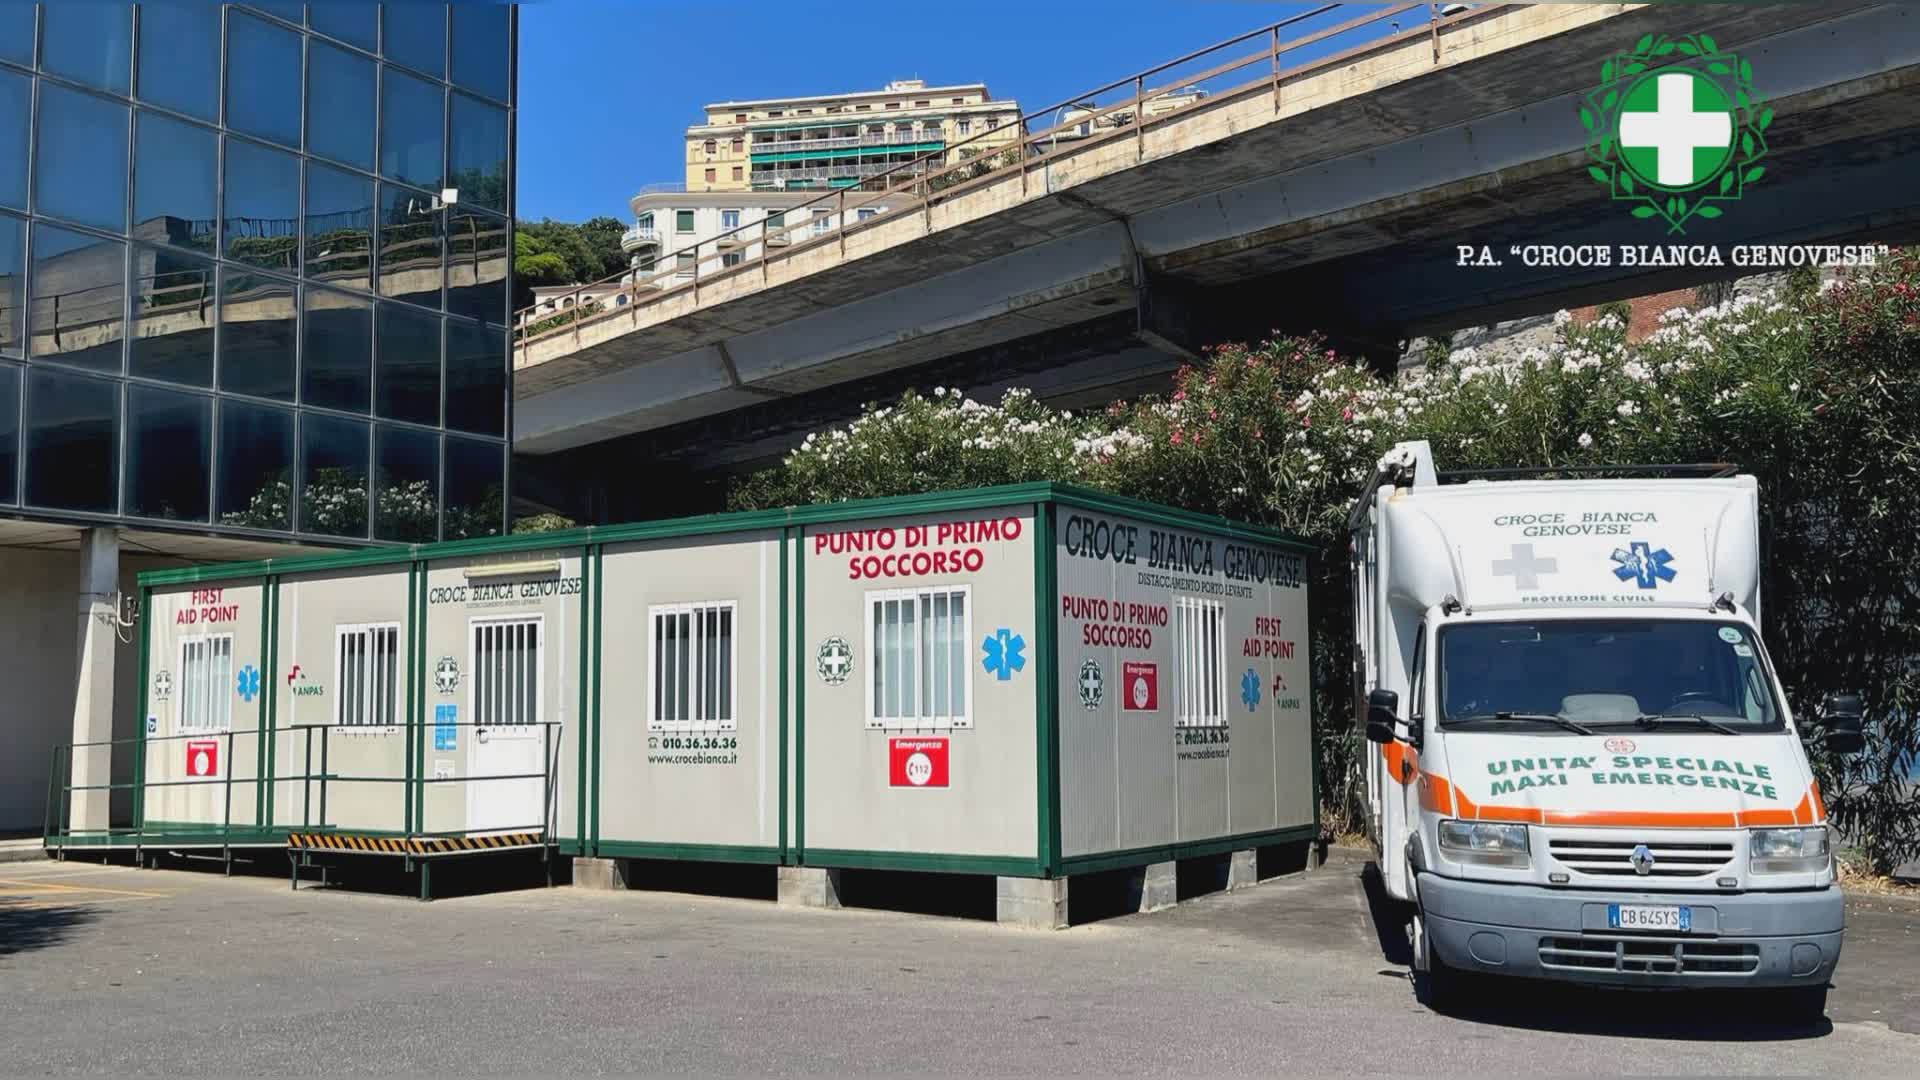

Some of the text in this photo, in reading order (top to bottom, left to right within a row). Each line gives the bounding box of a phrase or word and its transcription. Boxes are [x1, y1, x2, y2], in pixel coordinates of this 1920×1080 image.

[1494, 511, 1658, 527] CROCE BIANCA
[1523, 523, 1632, 537] GENOVESE
[815, 516, 1022, 555] PUNTO DI PRIMO
[1065, 514, 1301, 589] CROCE BIANCA GENOVESE
[848, 547, 984, 580] SOCCORSO
[192, 587, 223, 605] FIRST
[430, 577, 582, 604] CROCE BIANCA GENOVESE
[1137, 572, 1253, 600] DISTACCAMENTO PORTO LEVANTE
[1522, 594, 1656, 603] PROTEZIONE CIVILE
[176, 605, 239, 625] AID POINT
[1062, 595, 1168, 627] PUNTO DI PRIMO
[1083, 623, 1152, 649] SOCCORSO
[1255, 617, 1281, 637] FIRST
[1243, 639, 1295, 660] AID POINT
[662, 737, 737, 750] 010.36.36.36
[648, 751, 737, 764] www.crocebianca.it
[1612, 756, 1773, 780] SPECIALE
[1489, 772, 1779, 800] MAXI EMERGENZE
